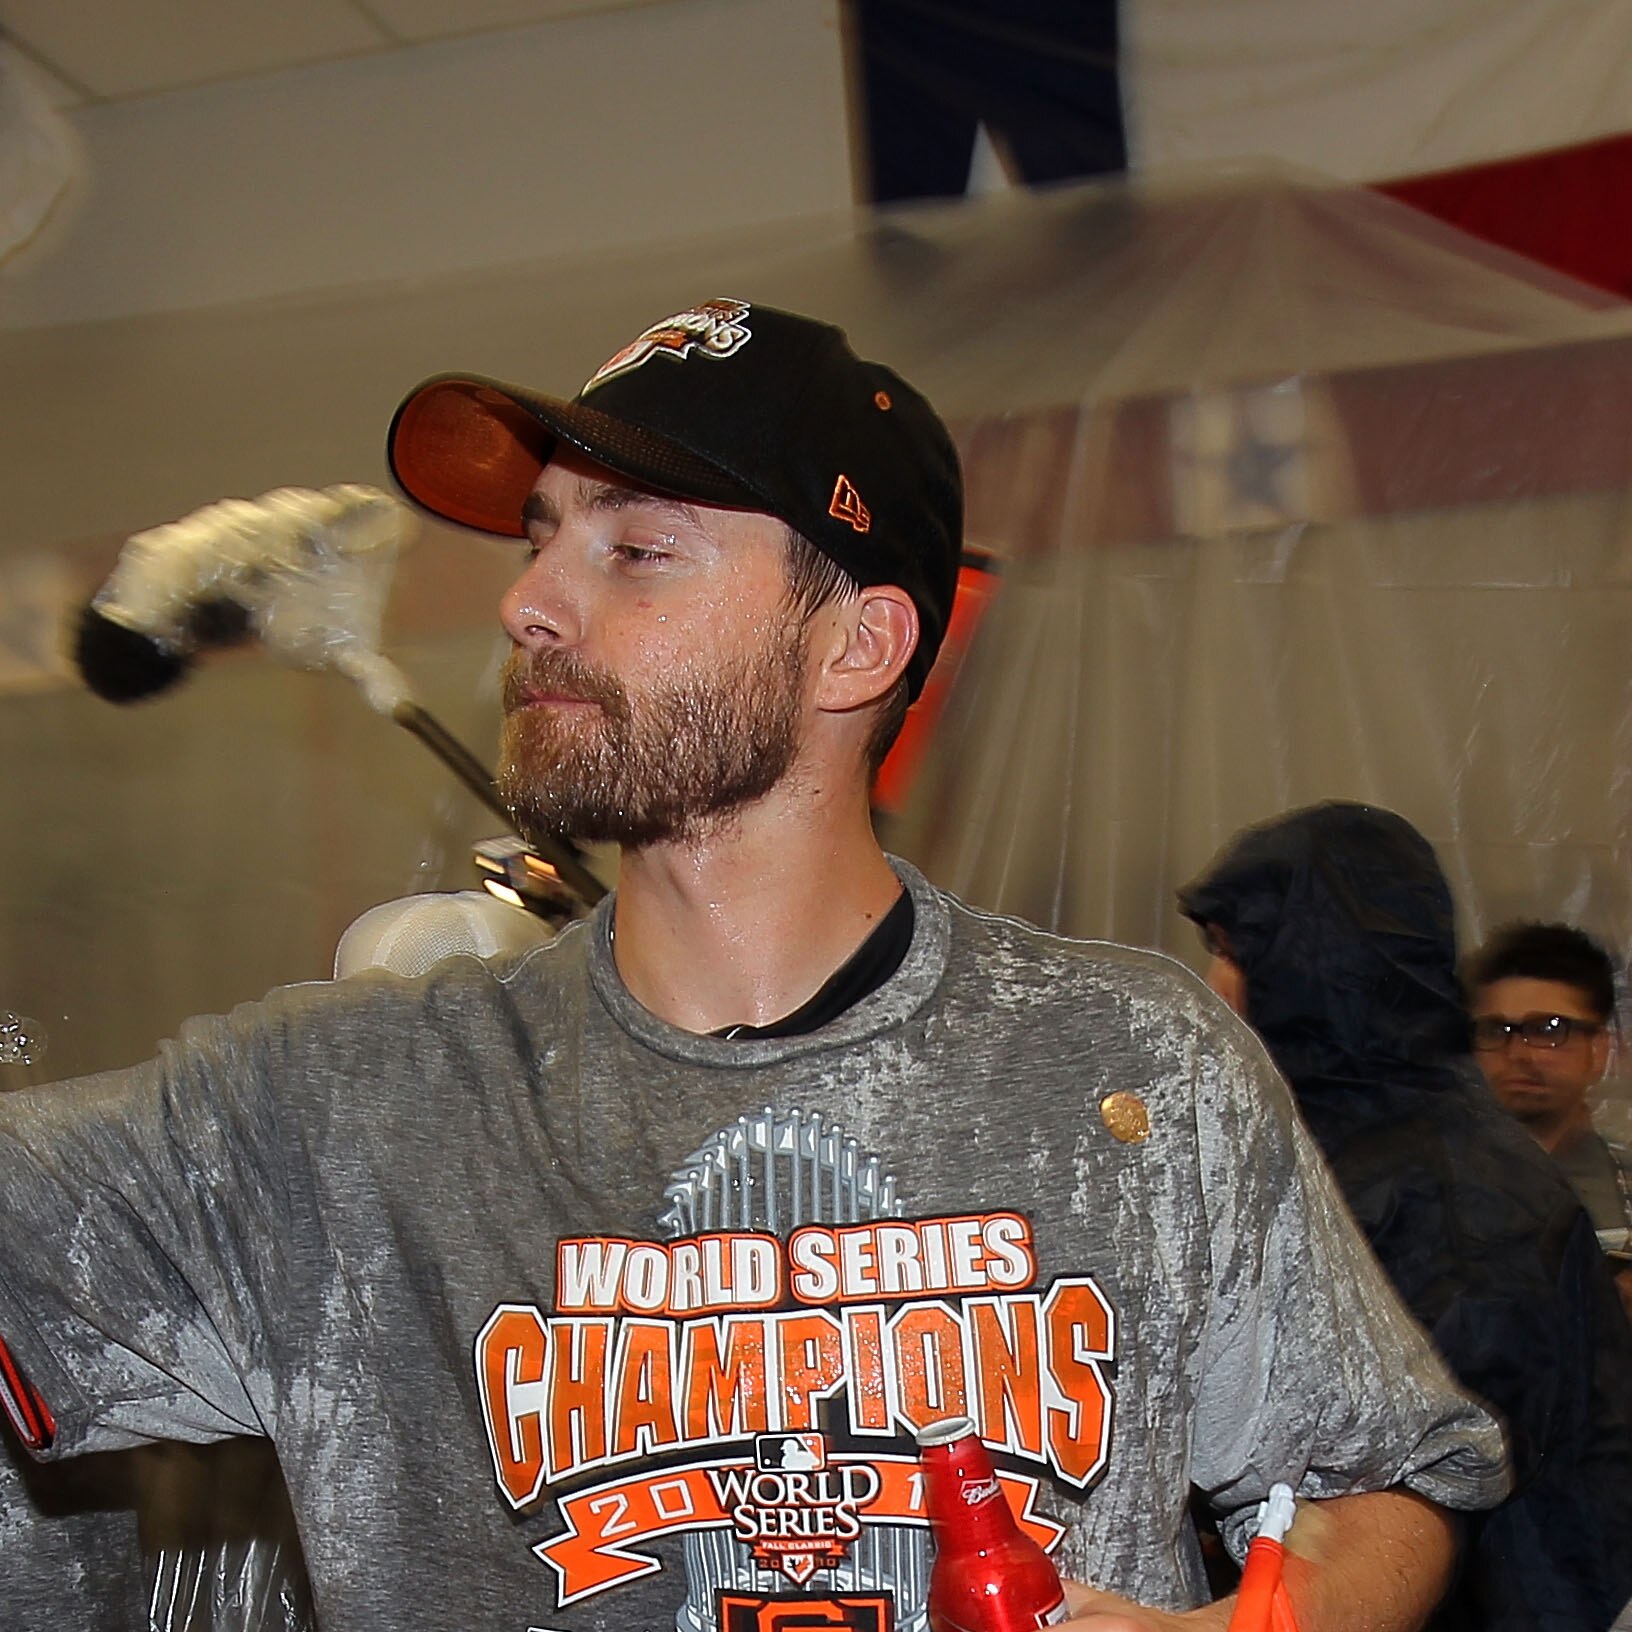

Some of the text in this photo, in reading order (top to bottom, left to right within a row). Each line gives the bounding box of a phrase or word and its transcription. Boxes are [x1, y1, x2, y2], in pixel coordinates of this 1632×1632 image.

[562, 1218, 1031, 1311] WORLD SERIES
[475, 1277, 1116, 1509] CHAMPIONS
[590, 1479, 694, 1538] 20
[708, 1465, 881, 1507] WORLD
[734, 1503, 862, 1540] SERIES
[762, 1540, 832, 1551] FALL CLASSIC
